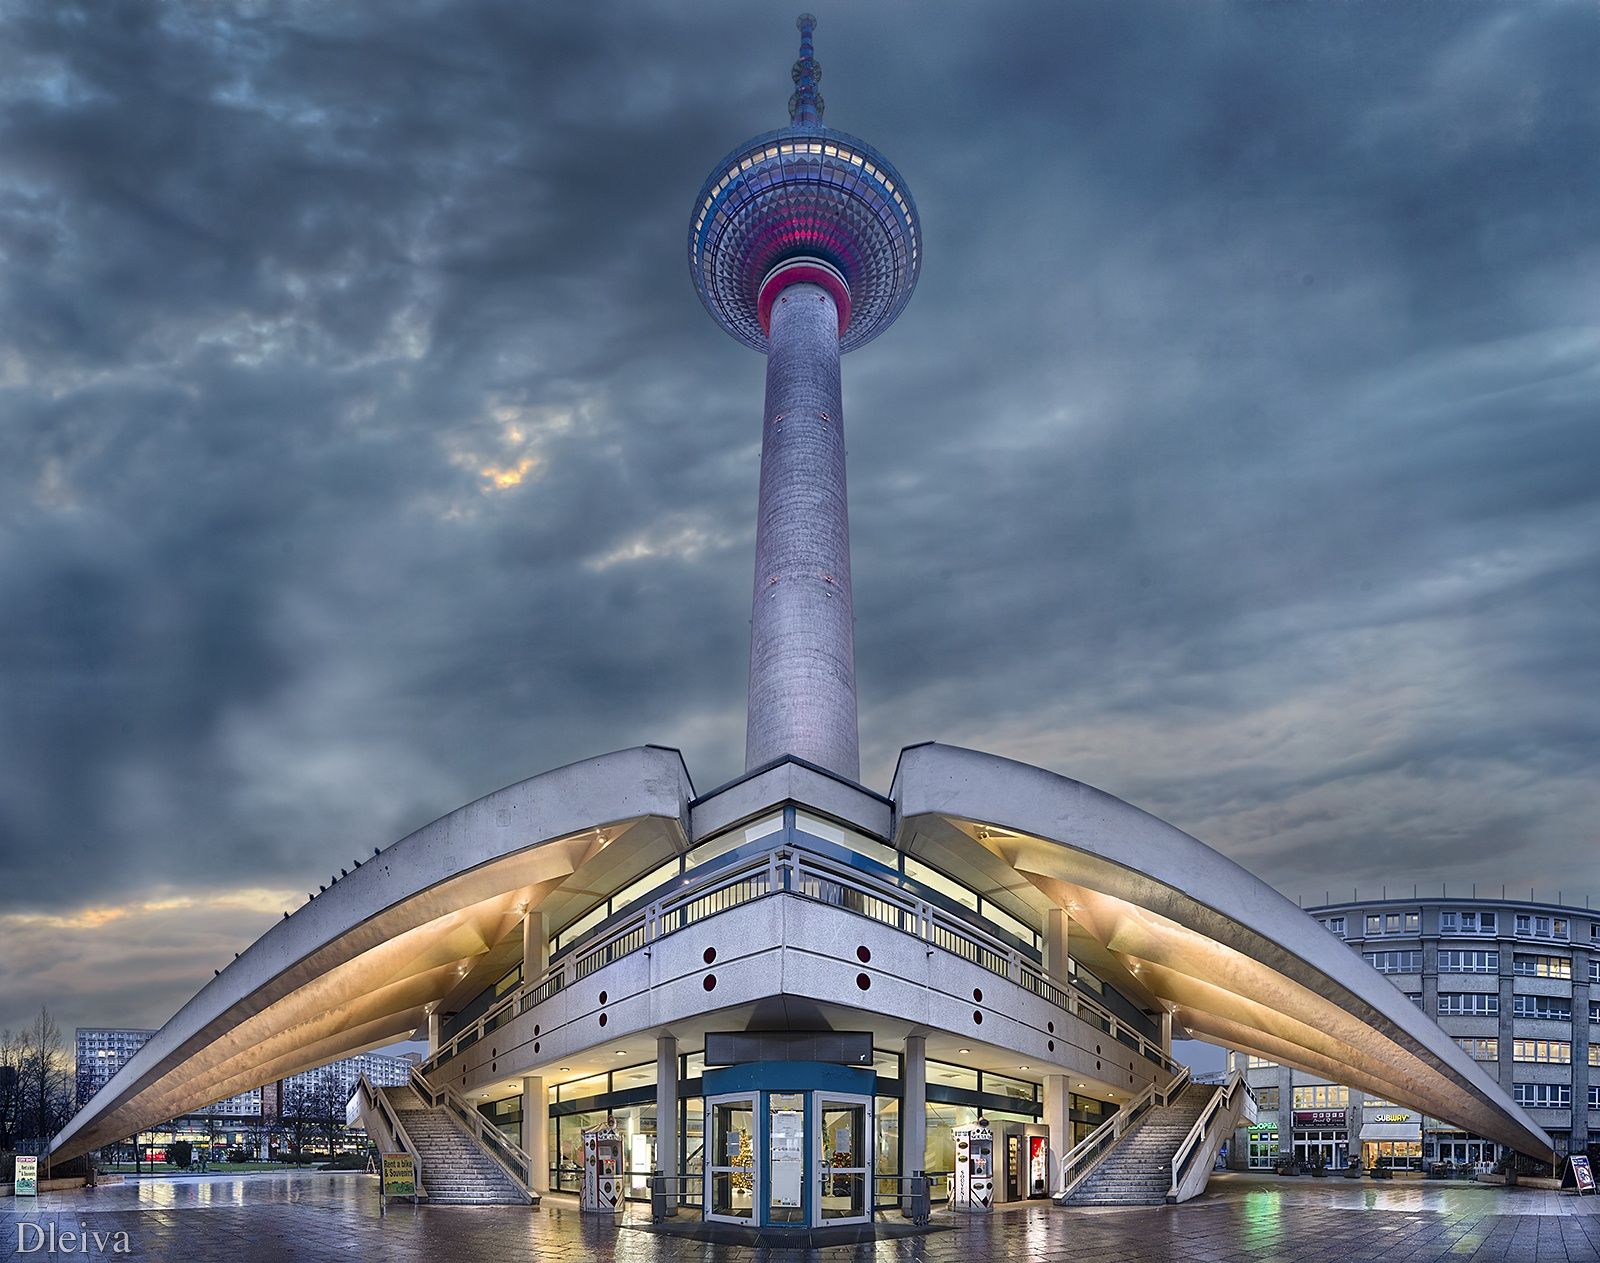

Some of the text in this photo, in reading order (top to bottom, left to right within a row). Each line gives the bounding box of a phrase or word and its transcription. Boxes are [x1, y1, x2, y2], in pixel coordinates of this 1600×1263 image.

[1374, 1114, 1410, 1122] SUBWAY
[383, 1159, 396, 1168] Rent
[401, 1159, 413, 1168] bike
[389, 1168, 413, 1177] Souvenirs
